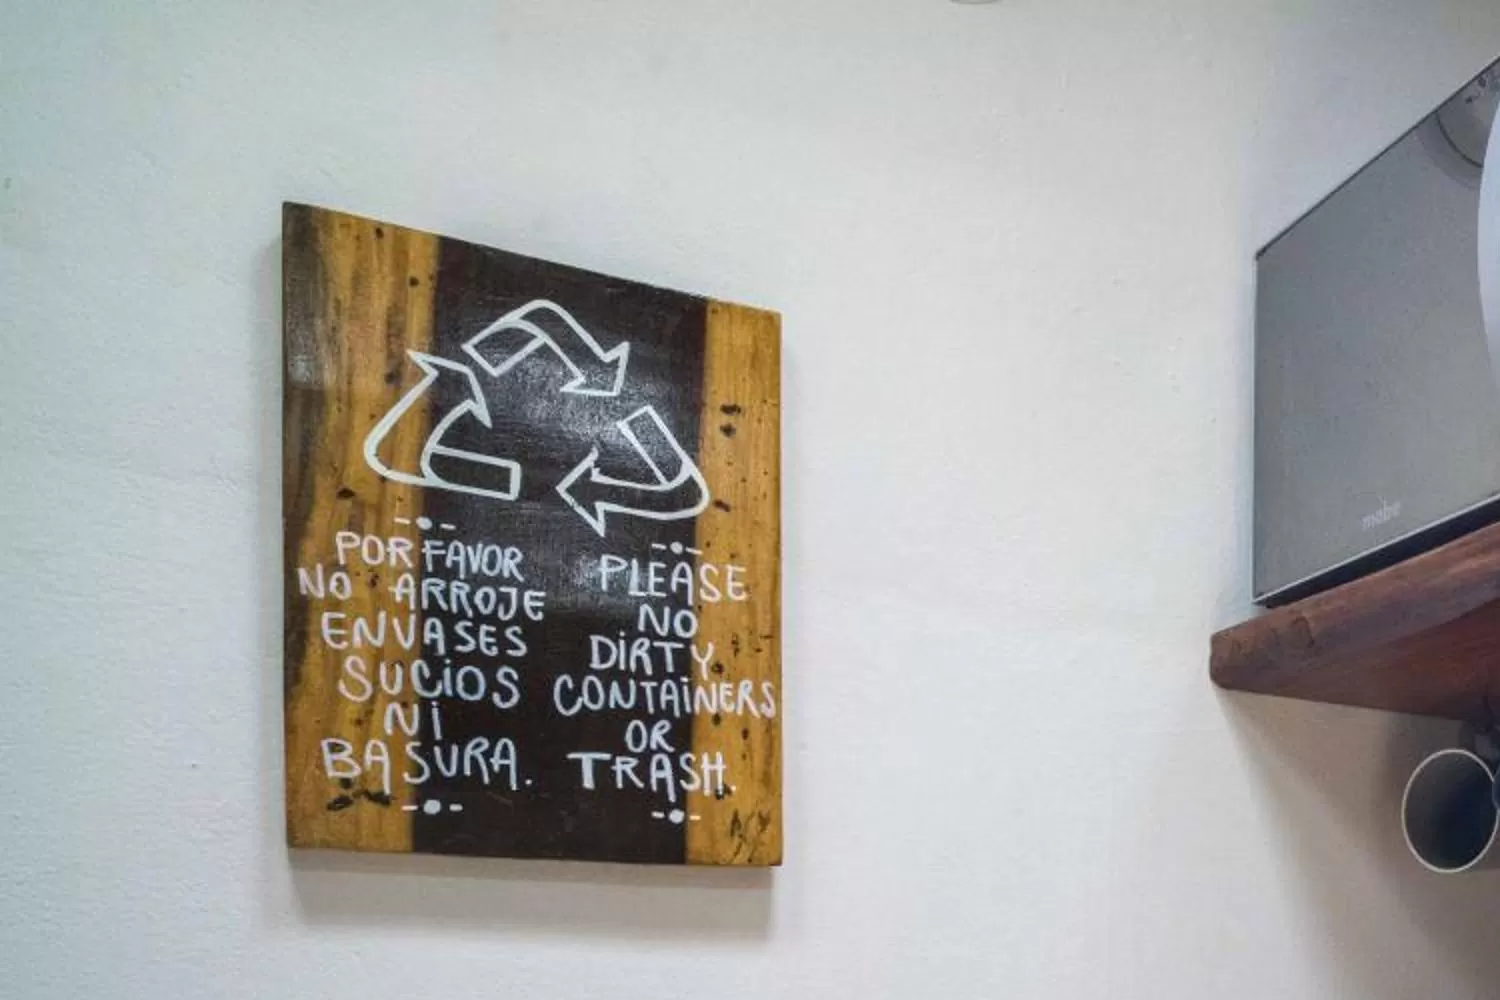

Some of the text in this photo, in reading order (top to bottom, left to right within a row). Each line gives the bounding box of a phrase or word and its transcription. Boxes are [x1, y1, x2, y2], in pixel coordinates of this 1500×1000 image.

[335, 530, 525, 583] POR FAVOR
[600, 554, 749, 606] PLEASE
[298, 567, 547, 621] NO ARROJE
[321, 611, 528, 658] ENVASES
[637, 604, 698, 639] NO
[626, 720, 675, 753] OR
